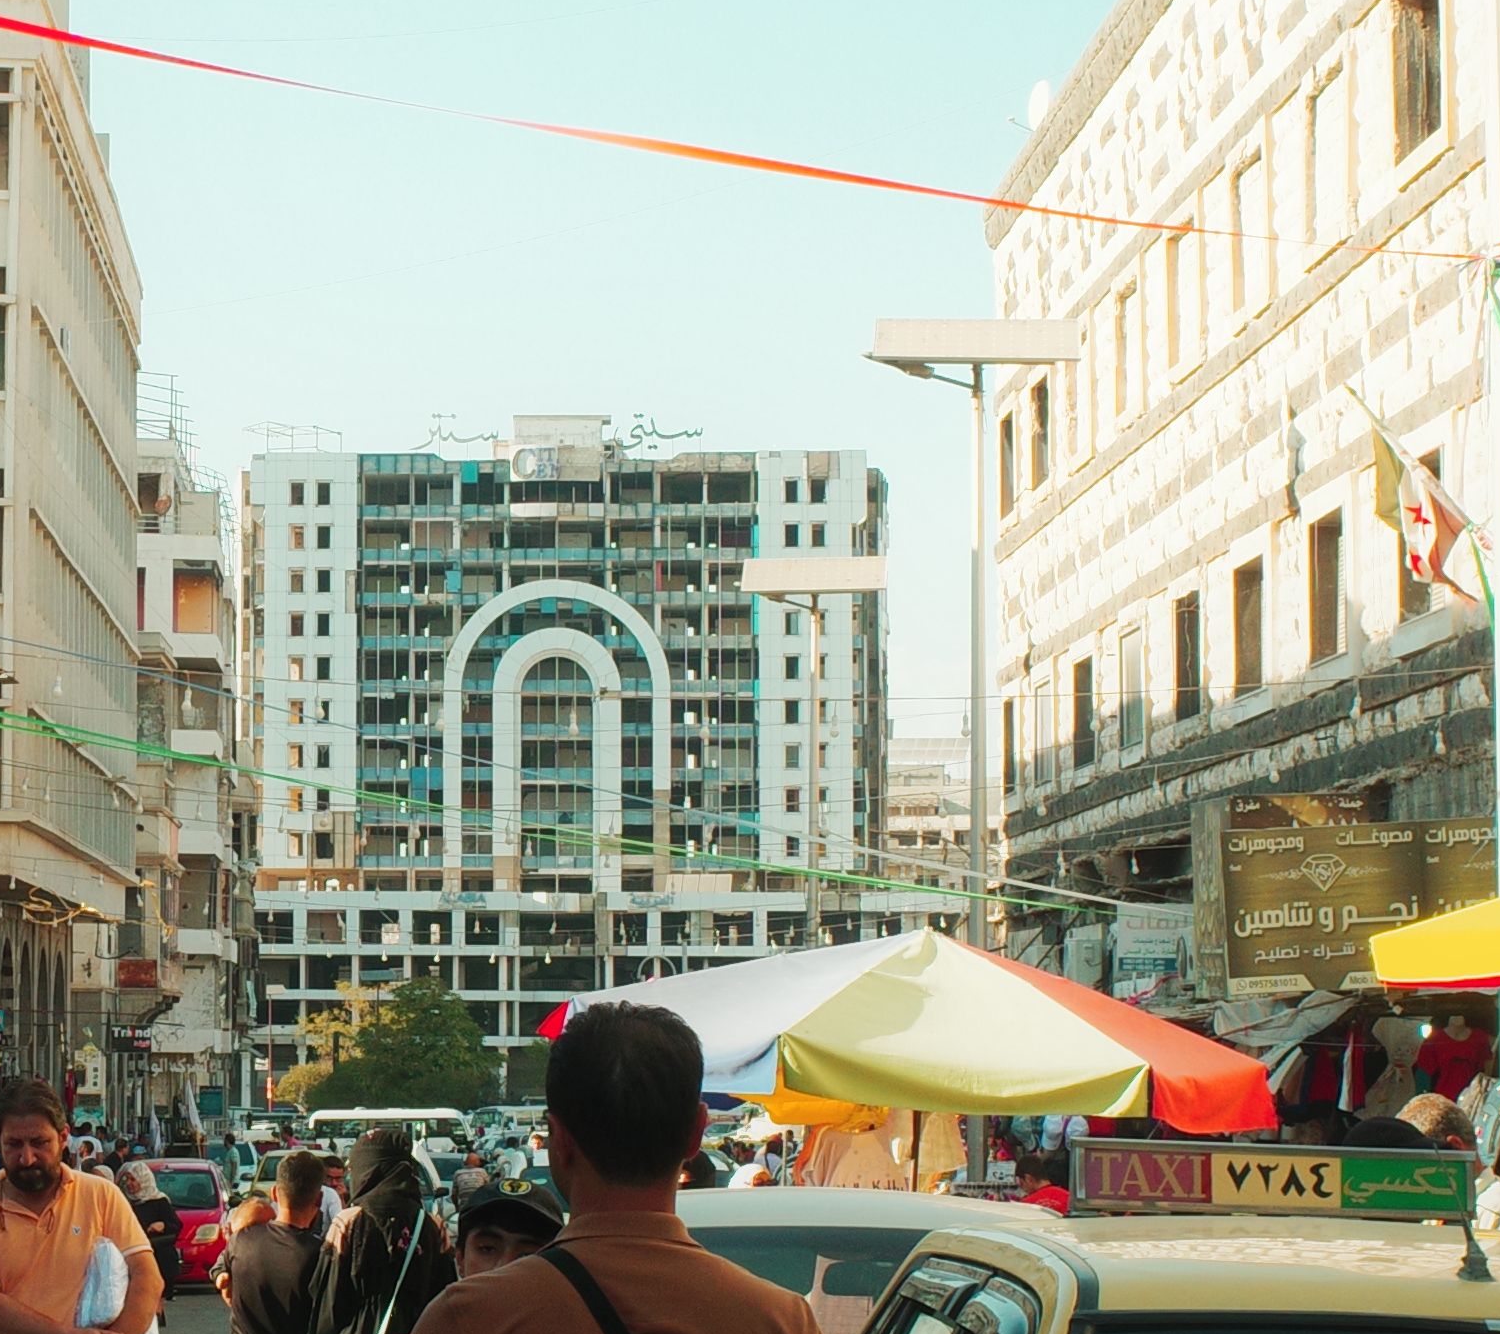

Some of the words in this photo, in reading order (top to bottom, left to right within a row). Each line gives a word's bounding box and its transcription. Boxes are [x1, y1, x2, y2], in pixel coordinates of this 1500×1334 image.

[1228, 835, 1305, 855] ومجوهرات
[1234, 901, 1314, 938] شاهين
[1319, 910, 1335, 932] و
[1254, 946, 1300, 965] تصليح
[1090, 1151, 1211, 1203] TAXI
[1343, 1165, 1458, 1204] تكسي
